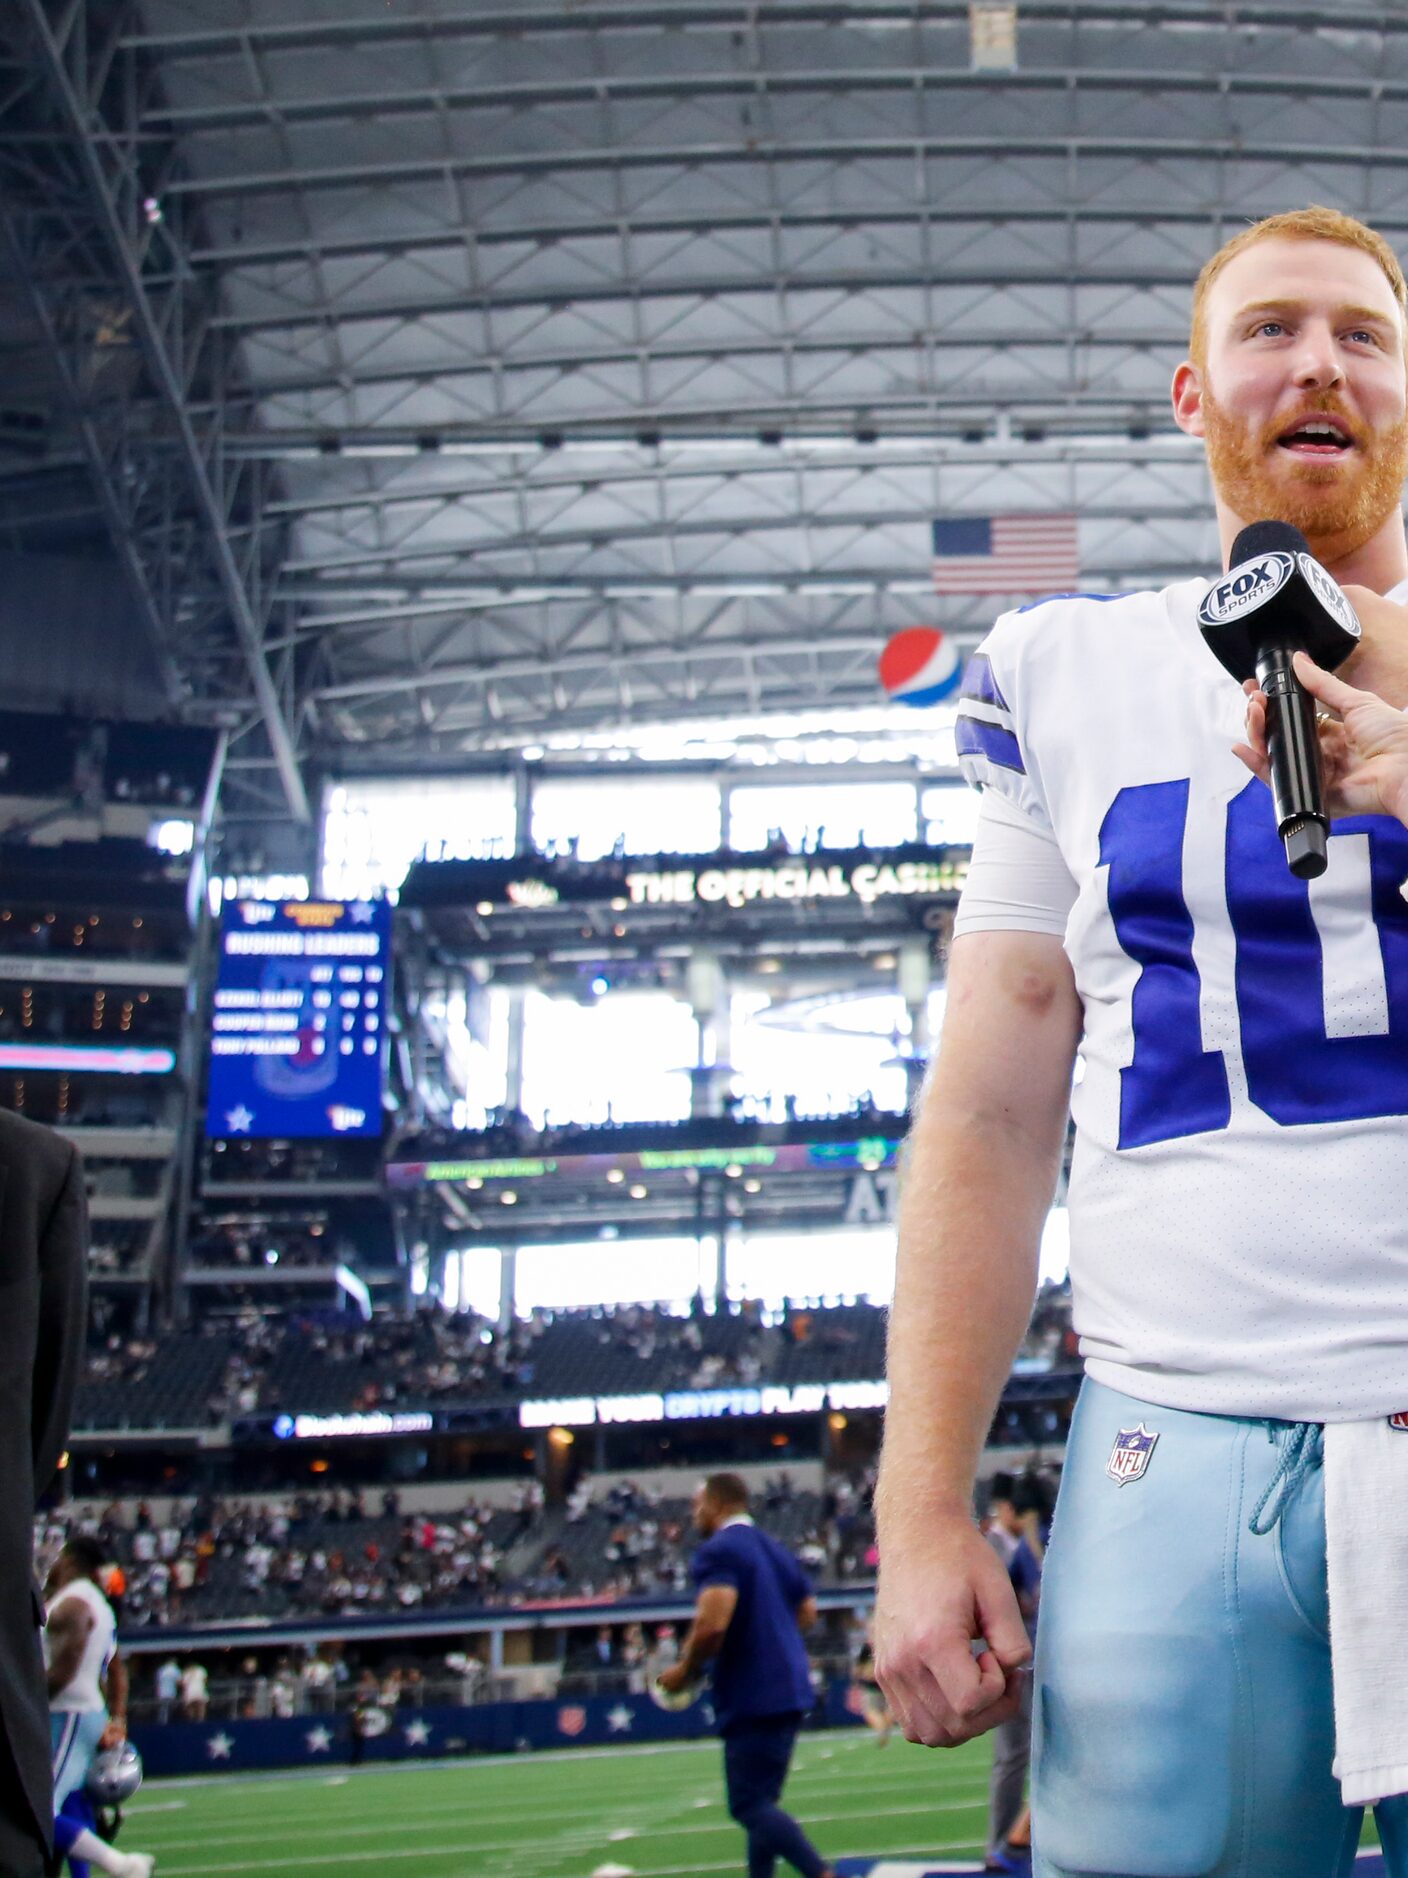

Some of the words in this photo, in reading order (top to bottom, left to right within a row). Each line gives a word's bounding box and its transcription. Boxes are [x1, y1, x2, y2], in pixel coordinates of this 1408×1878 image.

[1217, 561, 1273, 608] FOX
[1218, 582, 1276, 617] SPORTS
[1311, 563, 1348, 617] FOX
[626, 871, 696, 904] THE
[696, 865, 849, 902] OFFICIAL
[664, 1388, 760, 1419] CRYPTO
[1113, 1450, 1142, 1475] NFL
